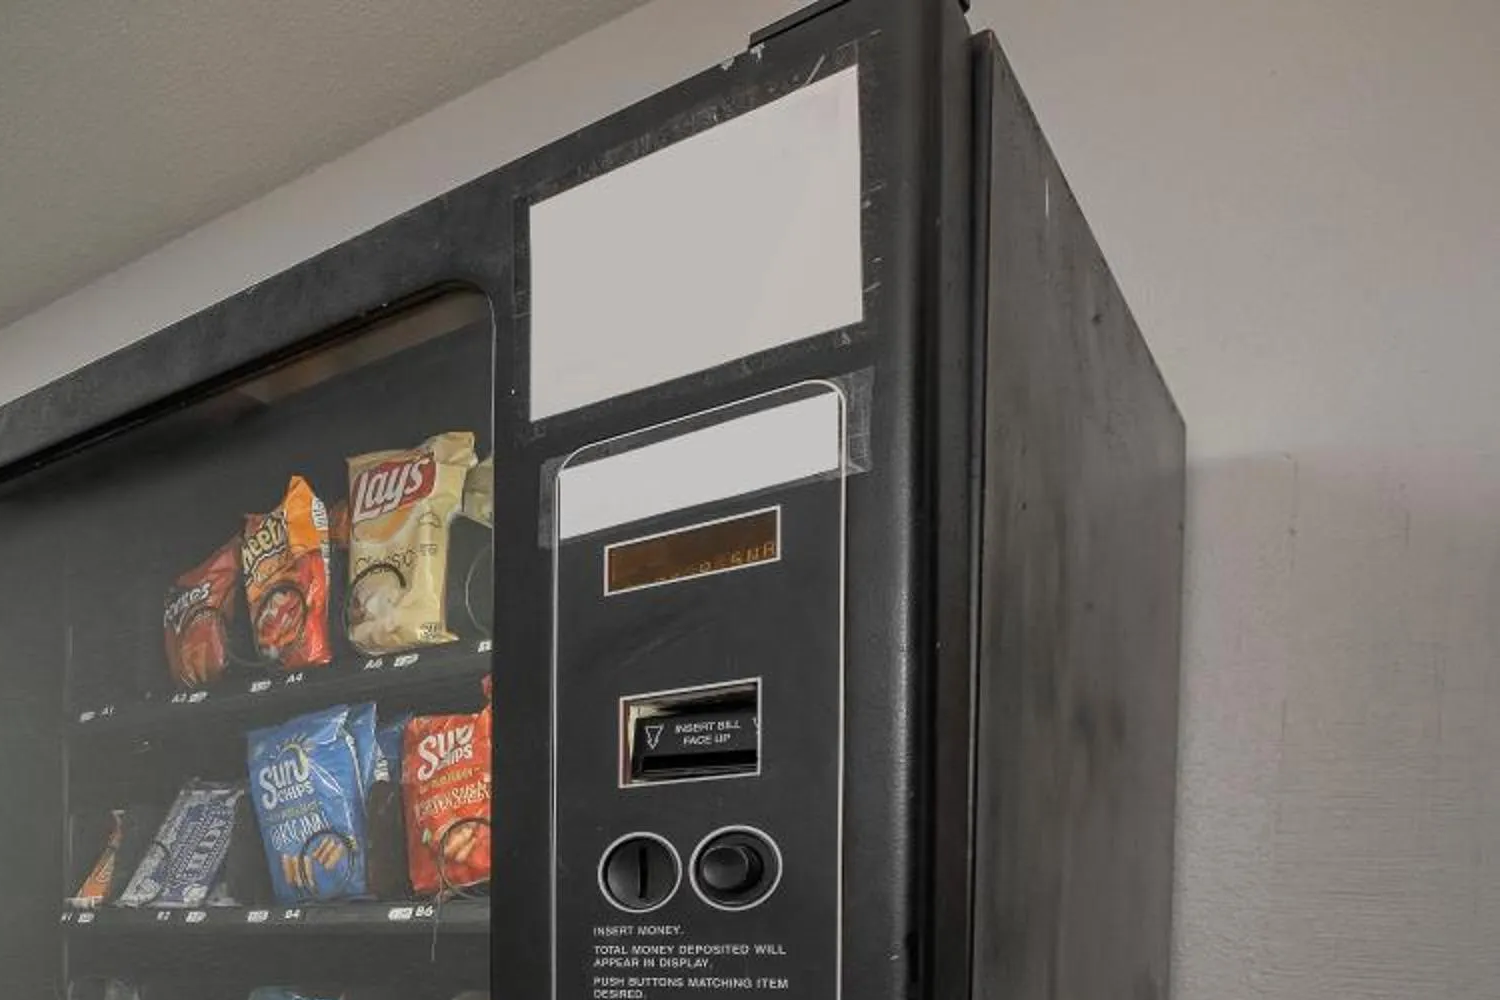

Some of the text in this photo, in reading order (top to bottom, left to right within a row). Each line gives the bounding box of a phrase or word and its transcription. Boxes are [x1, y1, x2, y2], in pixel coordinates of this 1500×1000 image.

[675, 719, 740, 734] INSERT BILL
[683, 732, 731, 745] FACE UP
[276, 780, 315, 803] CHIPS
[415, 905, 435, 917] B6
[593, 926, 633, 936] INSERT
[594, 943, 787, 955] TOTAL MONEY DEPOSITED WILL
[593, 957, 712, 969] APPEAR IN DISPLAY.
[593, 976, 789, 989] PUSH BUTTONS MATCHING ITEM
